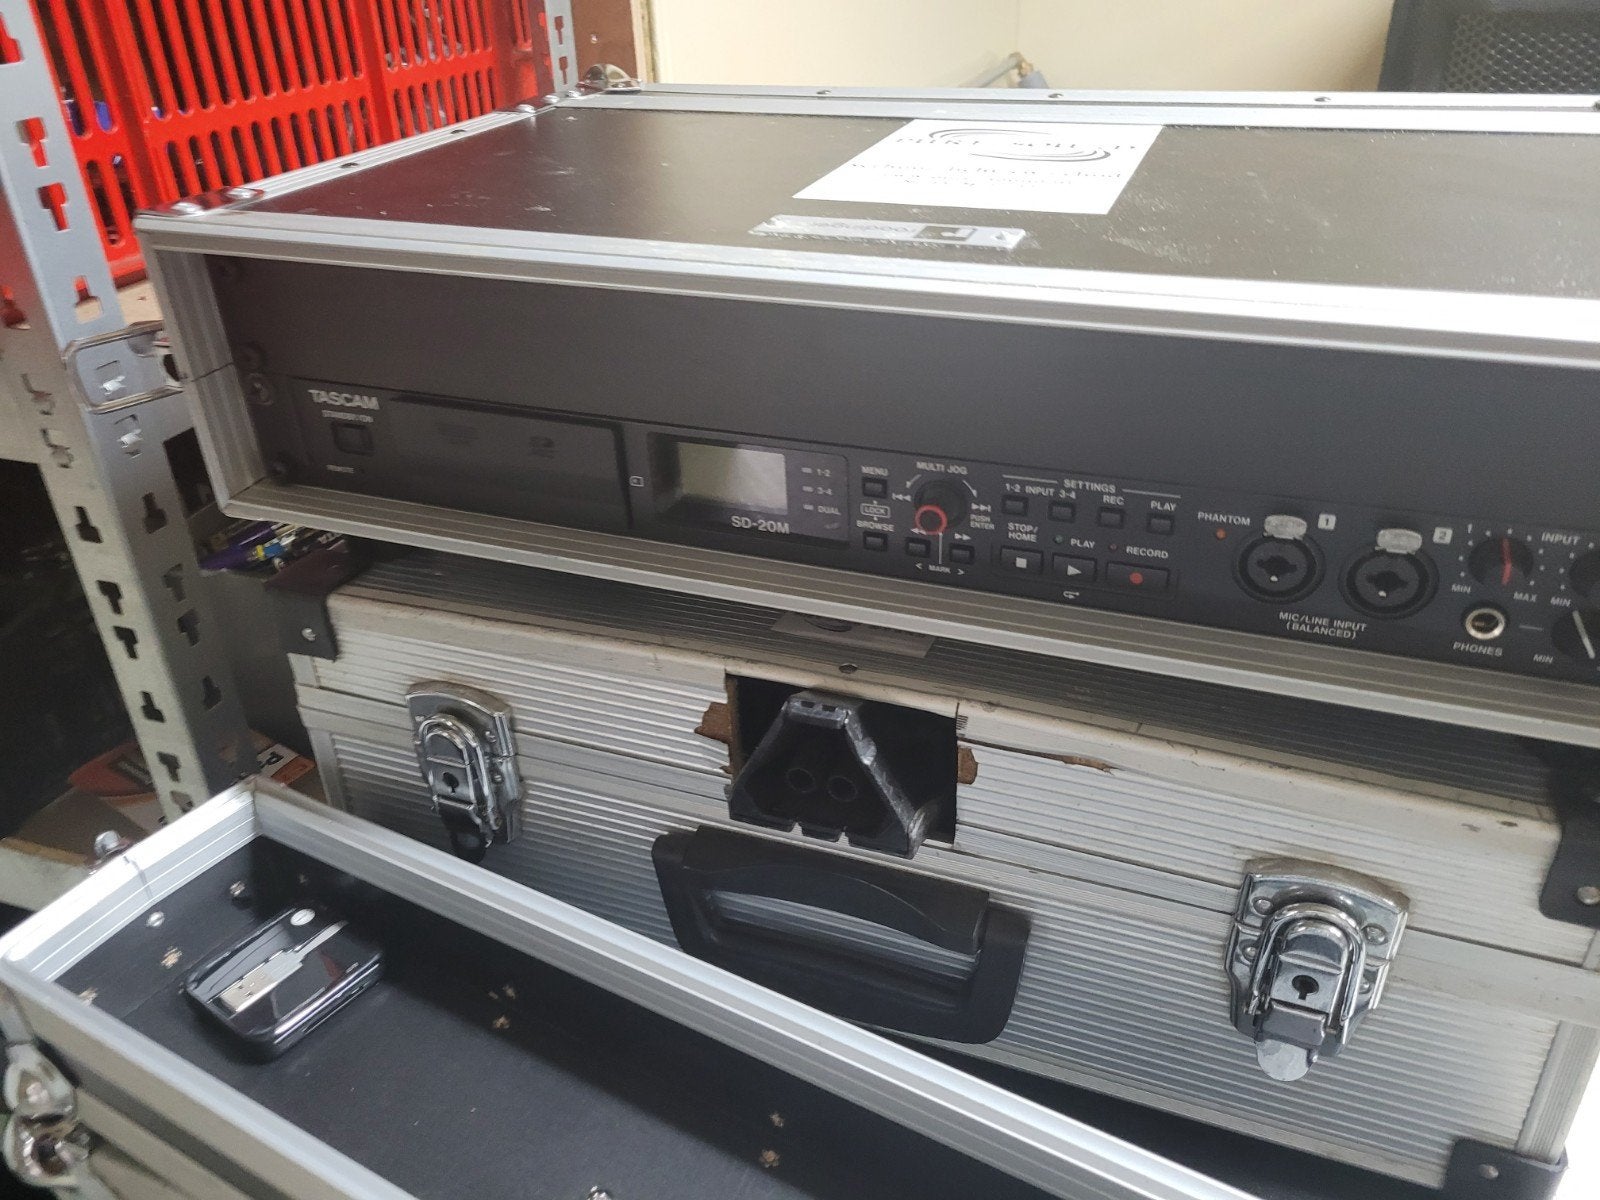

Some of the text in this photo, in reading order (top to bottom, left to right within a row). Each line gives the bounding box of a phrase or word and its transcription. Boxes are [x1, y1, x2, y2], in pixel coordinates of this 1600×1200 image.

[308, 389, 380, 410] TASCAM
[861, 466, 888, 476] MENU
[917, 462, 968, 474] MULTI JOG
[1006, 484, 1076, 499] 1-2 INPUT 3-4
[1063, 479, 1116, 494] SETTINGS
[1103, 495, 1124, 505] REC
[818, 506, 840, 515] DUAL
[864, 506, 886, 515] LOCK
[1151, 501, 1176, 511] PLAY
[971, 514, 990, 522] PUSH
[1198, 512, 1250, 525] PHANTOM
[731, 515, 790, 534] SD-20M
[857, 519, 894, 531] BROWSE
[970, 521, 994, 529] ENTER
[1008, 523, 1038, 532] STOP/
[1008, 531, 1037, 542] HOME
[1542, 533, 1580, 545] INPUT
[1071, 538, 1094, 548] PLAY
[1126, 546, 1168, 558] RECORD
[1452, 584, 1470, 593] MIN
[1514, 592, 1537, 602] MAX
[1551, 597, 1571, 607] MIN
[1279, 611, 1368, 632] MIC/LINE INPUT
[1286, 621, 1357, 640] (BALANCED)
[1453, 642, 1502, 656] PHONES
[1534, 654, 1553, 663] MIN
